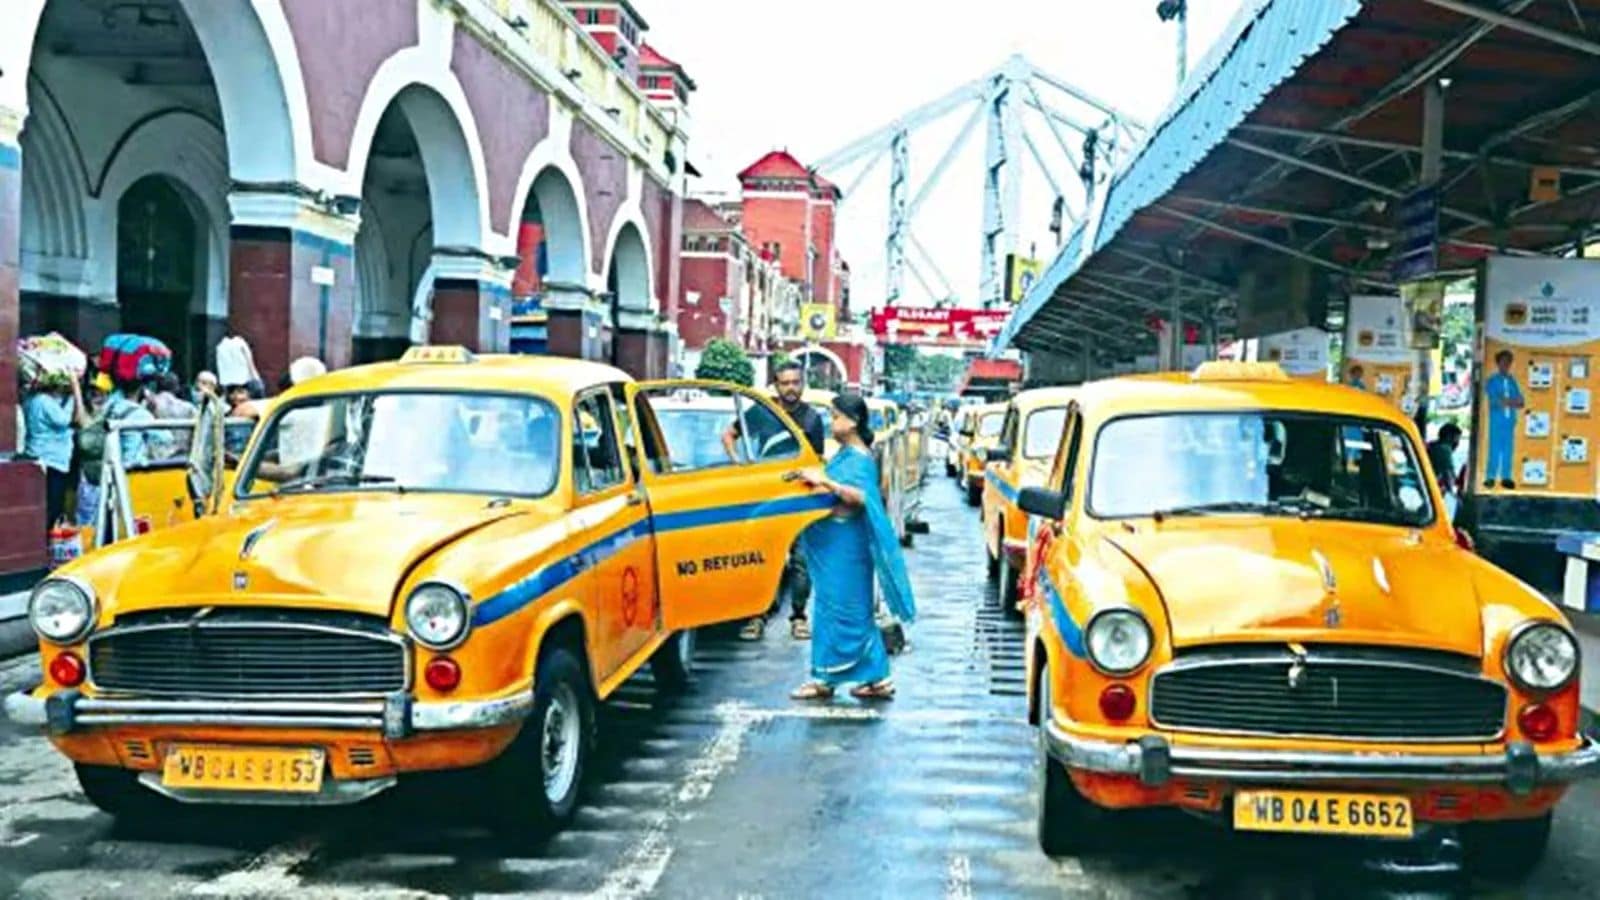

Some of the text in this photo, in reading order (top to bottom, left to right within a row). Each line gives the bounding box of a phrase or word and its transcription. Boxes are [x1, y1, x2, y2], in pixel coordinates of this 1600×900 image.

[677, 551, 764, 576] NO REFUSAL
[1255, 796, 1408, 828] WB 04 E 6652
